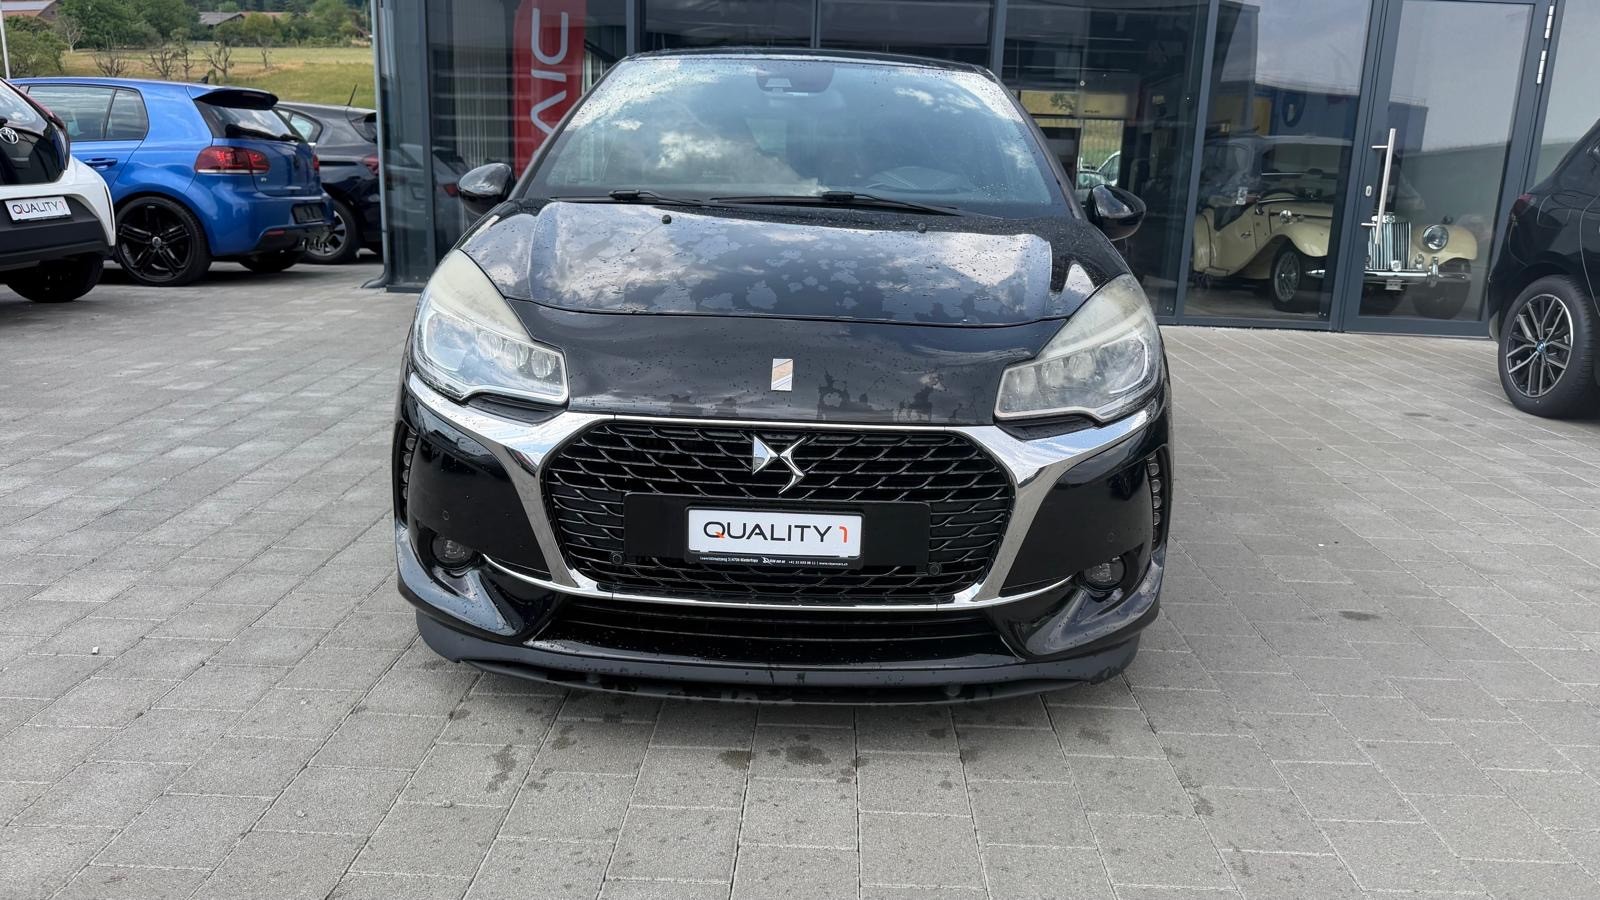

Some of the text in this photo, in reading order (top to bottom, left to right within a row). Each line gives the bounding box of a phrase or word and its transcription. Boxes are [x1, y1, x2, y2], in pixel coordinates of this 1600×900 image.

[12, 200, 66, 215] QUALITY 1
[703, 521, 848, 543] QUALITY 1
